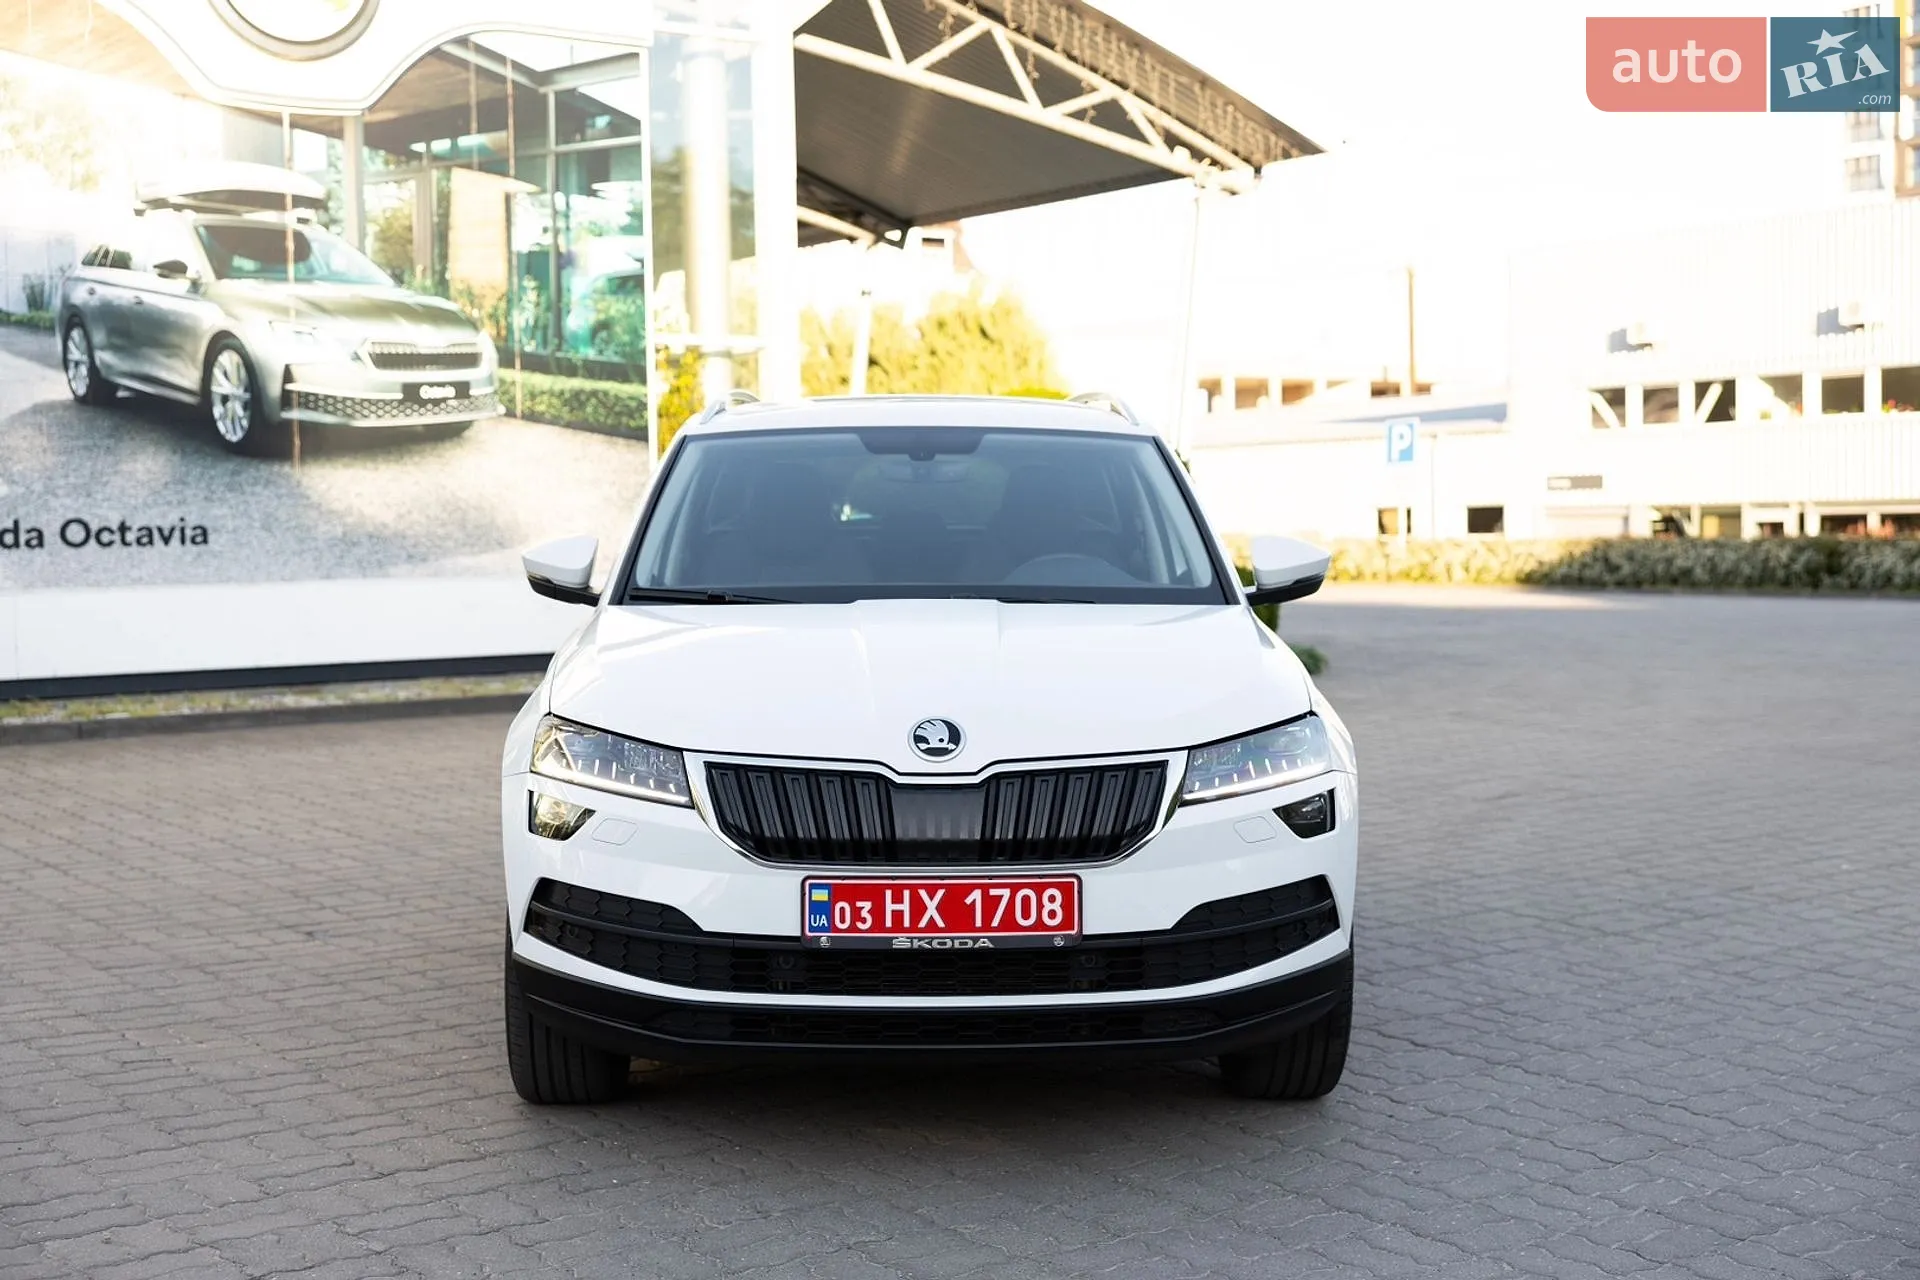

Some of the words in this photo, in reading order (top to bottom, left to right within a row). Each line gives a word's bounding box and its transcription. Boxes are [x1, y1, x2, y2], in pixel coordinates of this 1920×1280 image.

[1391, 422, 1412, 461] P
[59, 517, 209, 548] Octavia
[810, 914, 828, 927] UA
[834, 901, 873, 930] 03
[885, 889, 946, 928] HX
[964, 888, 1063, 927] 1708
[892, 937, 994, 949] ŠKODA
